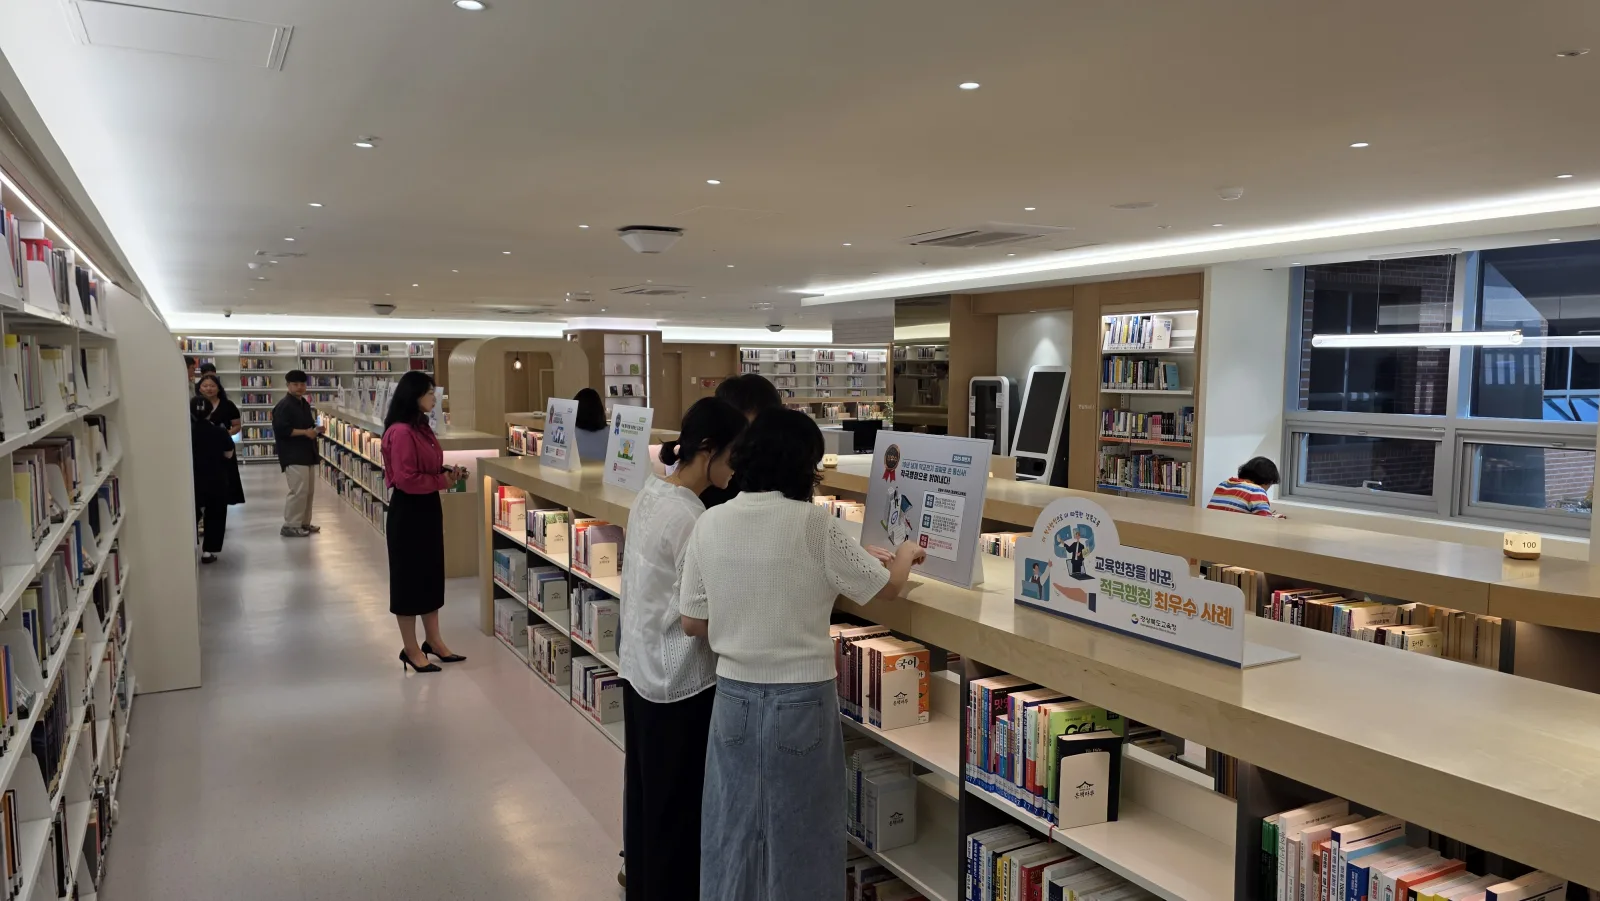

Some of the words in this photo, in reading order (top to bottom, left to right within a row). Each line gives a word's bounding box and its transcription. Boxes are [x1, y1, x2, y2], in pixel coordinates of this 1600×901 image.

[1522, 541, 1537, 549] 100
[1094, 556, 1146, 580] 교육현장을
[1149, 567, 1175, 589] 바꾼,
[1100, 577, 1151, 606] 적극행정
[1154, 590, 1198, 617] 최우수
[1201, 602, 1233, 627] 사례
[1139, 615, 1177, 631] 경상북도교육청
[897, 656, 917, 670] 국어
